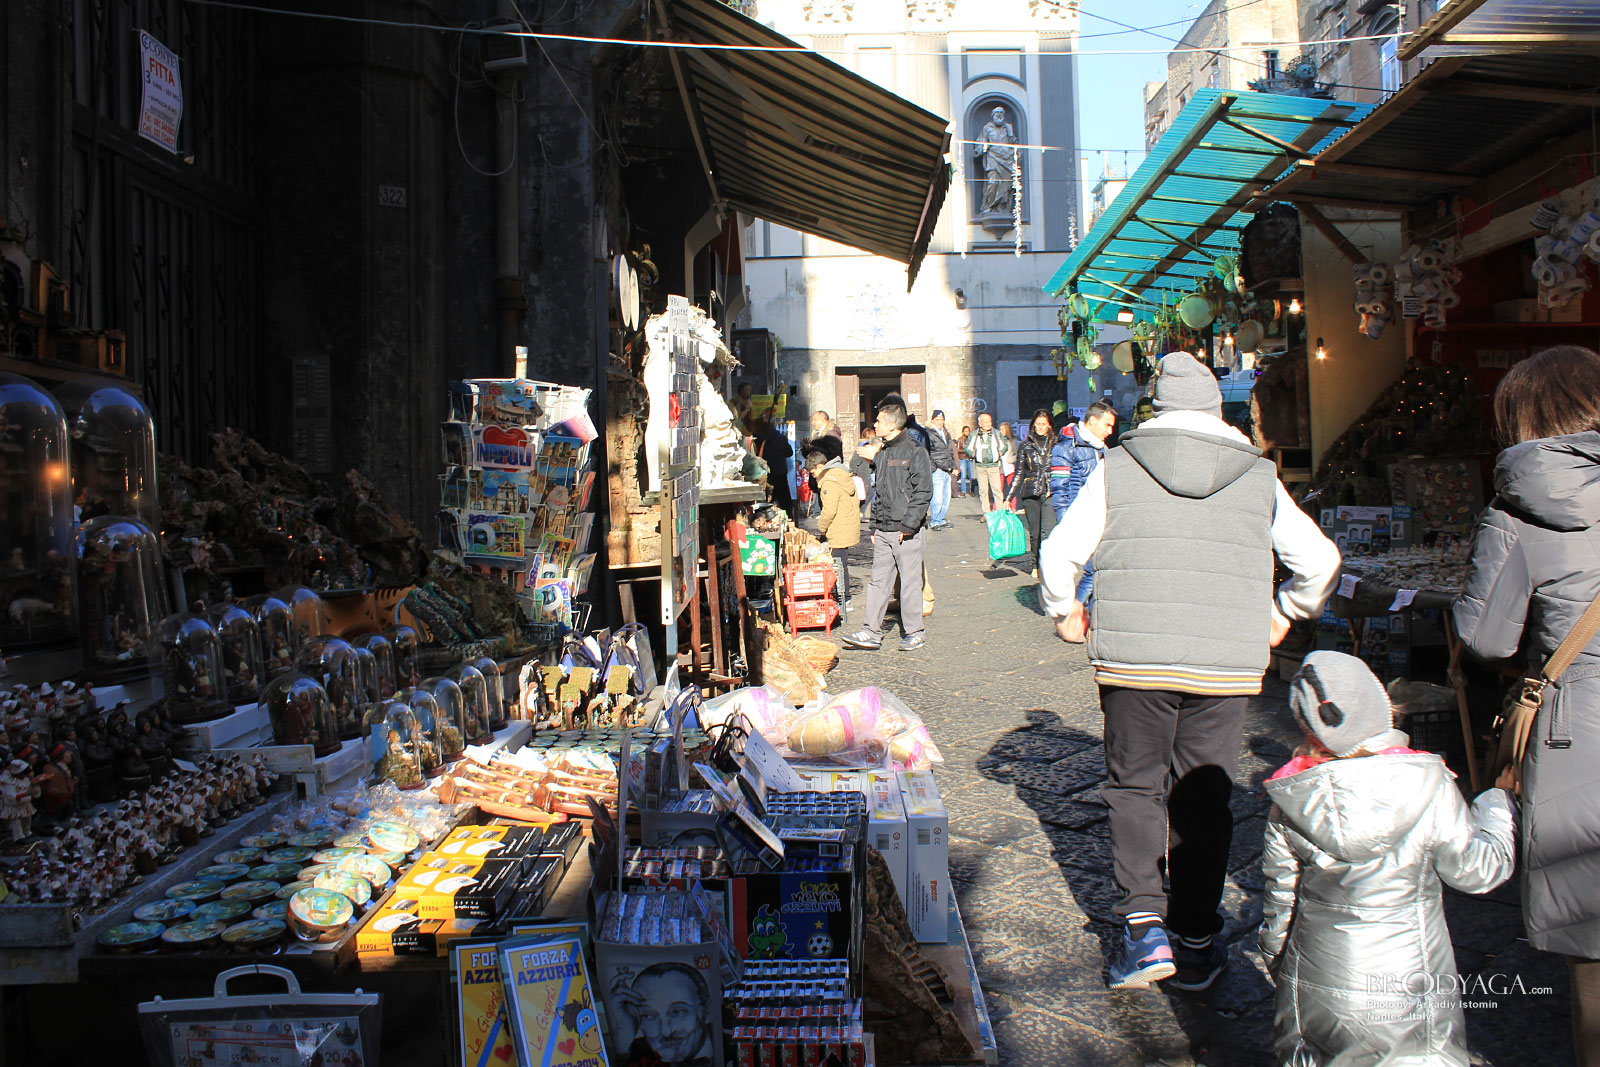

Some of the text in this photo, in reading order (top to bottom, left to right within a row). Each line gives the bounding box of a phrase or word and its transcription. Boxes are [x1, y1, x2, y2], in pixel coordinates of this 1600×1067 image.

[146, 70, 151, 84] 3
[149, 57, 176, 87] FITTA
[383, 188, 403, 205] 322
[477, 443, 531, 466] NAPOLI
[893, 842, 900, 850] CE
[934, 837, 940, 845] CE
[800, 881, 840, 892] forza
[791, 891, 838, 902] nero
[780, 899, 842, 914] azzurri
[472, 952, 497, 968] FOR
[521, 948, 570, 969] FORZA
[518, 962, 582, 986] AZZURRI
[173, 1027, 181, 1037] 6
[284, 1024, 291, 1034] 9
[468, 1038, 482, 1054] Le
[530, 1034, 544, 1051] Le
[325, 1052, 340, 1063] 20
